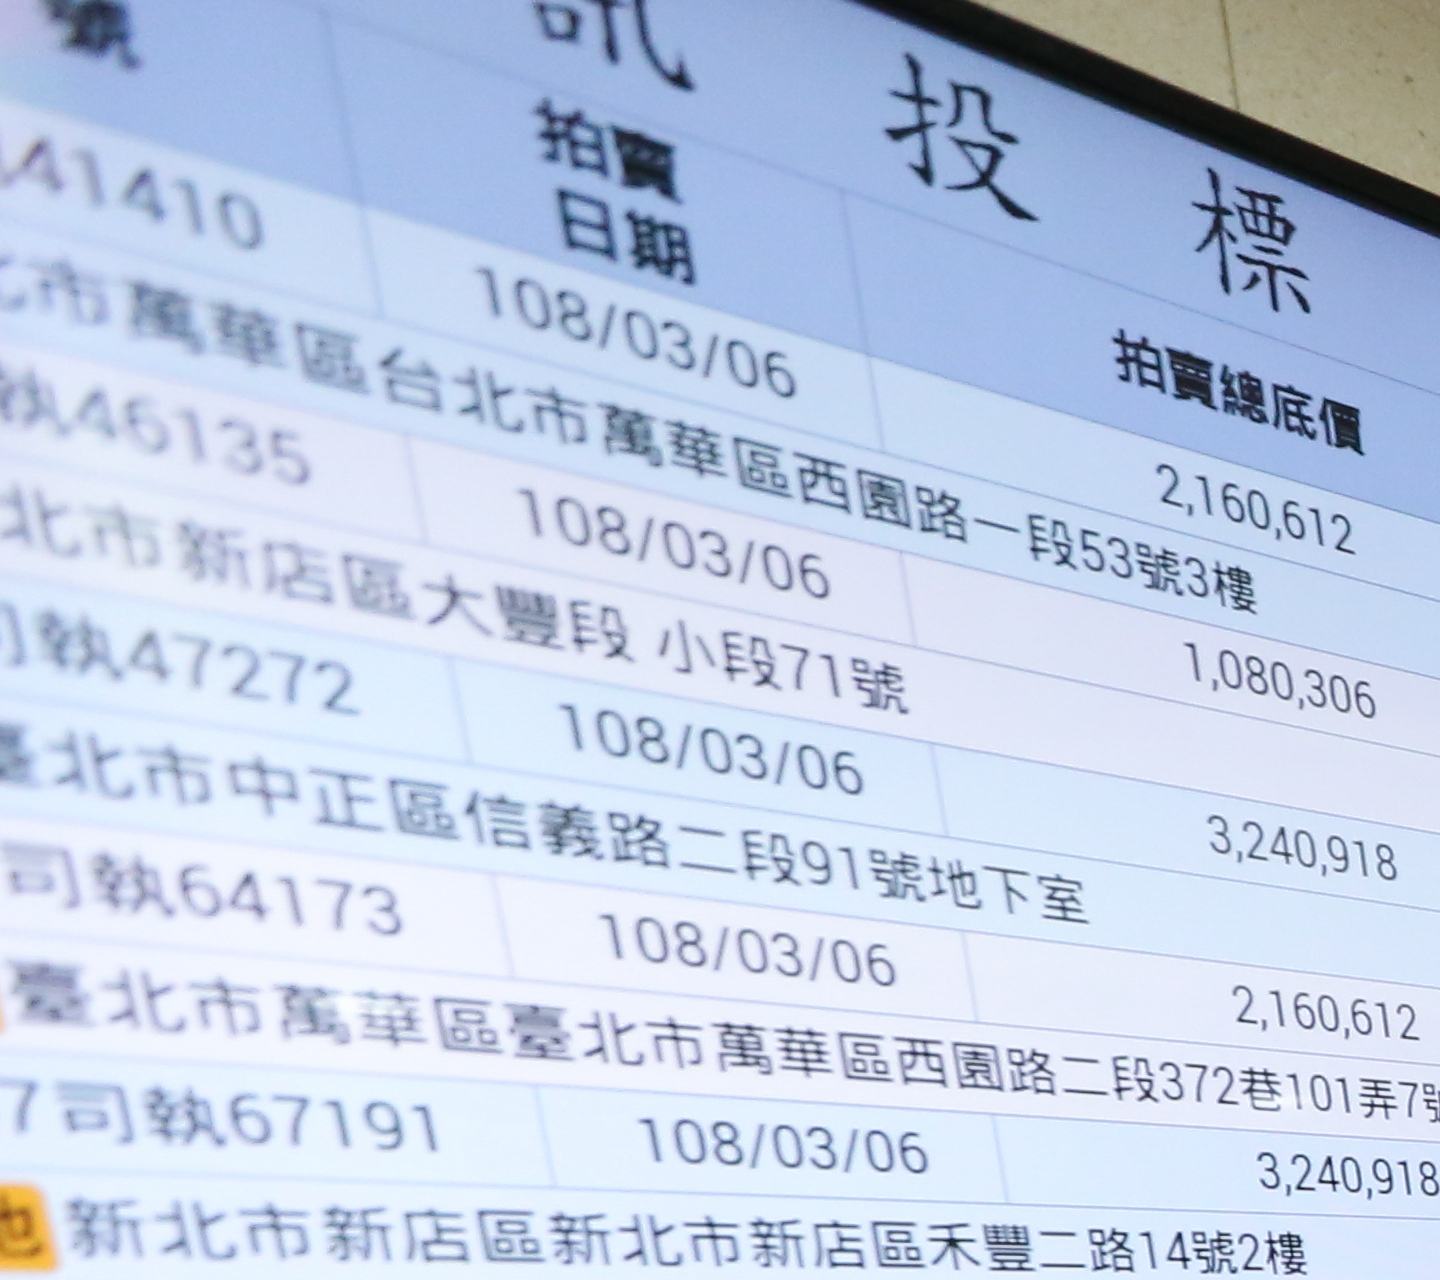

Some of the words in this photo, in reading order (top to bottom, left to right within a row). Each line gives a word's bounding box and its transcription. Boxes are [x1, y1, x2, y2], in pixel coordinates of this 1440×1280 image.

[535, 97, 686, 204] 拍賣
[555, 187, 698, 288] 日期
[473, 264, 798, 400] 108/03/06
[1112, 328, 1364, 457] 拍賣總底價
[518, 488, 830, 600] 108/03/06
[1156, 463, 1357, 559] 2,160,612
[657, 617, 911, 716] 小段71號
[1181, 640, 1379, 722] 1,080,306
[559, 700, 864, 796] 108/03/06
[1207, 814, 1399, 886] 3,240,918
[599, 910, 897, 988] 108/03/06
[1232, 985, 1421, 1042] 2,160,612
[638, 1116, 931, 1177] 108/03/06
[1255, 1151, 1440, 1199] 3,240,918
[66, 1197, 1309, 1279] 新北市新店區新北市新店區禾豐二路14號2樓
